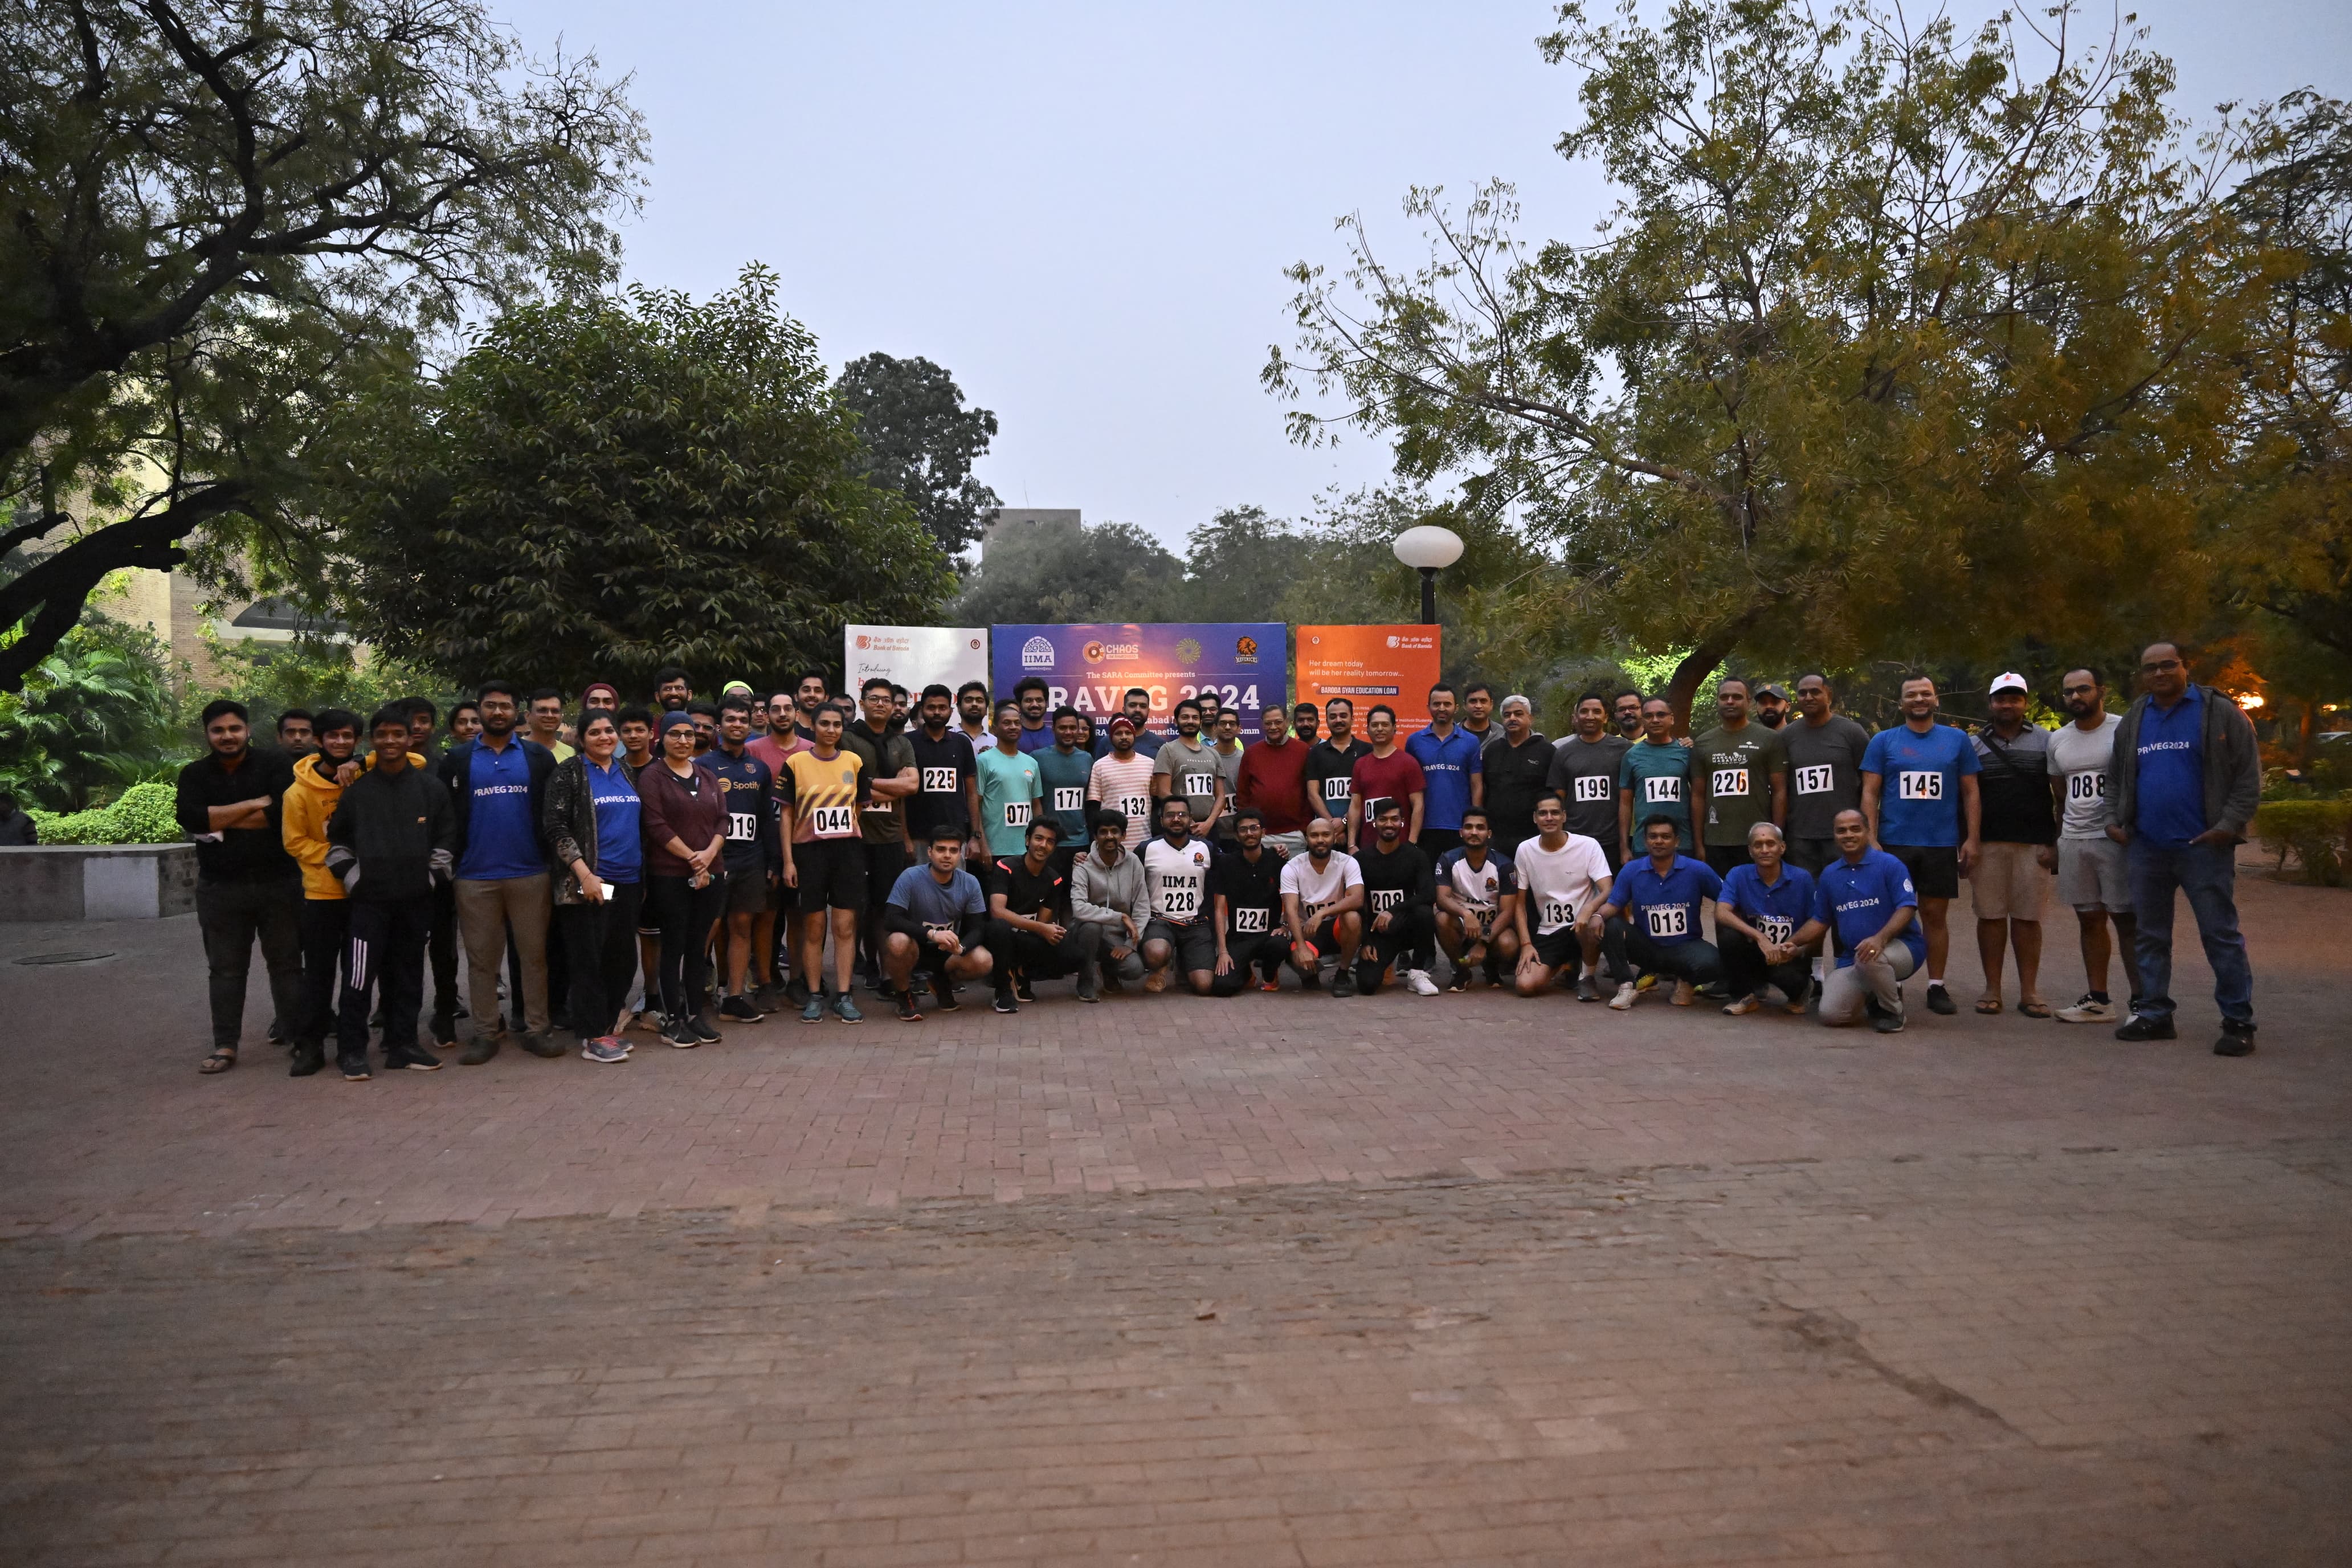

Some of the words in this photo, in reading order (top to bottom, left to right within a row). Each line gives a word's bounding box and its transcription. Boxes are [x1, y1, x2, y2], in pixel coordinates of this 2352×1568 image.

[1106, 644, 1138, 654] CHAOS
[857, 663, 892, 676] Introducing
[1047, 685, 1168, 712] RAVG
[1180, 685, 1260, 710] 224
[733, 781, 760, 790] Spotify
[926, 770, 956, 790] 225
[1188, 775, 1212, 794] 176
[1578, 778, 1610, 798] 199
[1648, 779, 1680, 799] 144
[1714, 771, 1747, 794] 226
[1798, 767, 1830, 792] 157
[1903, 775, 1940, 797] 145
[2072, 774, 2106, 799] 088
[594, 795, 625, 806] PRAVEG
[1056, 790, 1081, 808] 171
[1121, 797, 1145, 815] 132
[816, 809, 851, 832] 044
[1007, 804, 1030, 824] 077
[1162, 876, 1185, 888] IIM
[1188, 876, 1197, 888] A
[1165, 892, 1194, 912] 228
[1372, 892, 1403, 912] 208
[1859, 897, 1880, 908] 2024
[1239, 910, 1267, 930] 224
[1546, 903, 1574, 923] 133
[1651, 912, 1685, 934] 013
